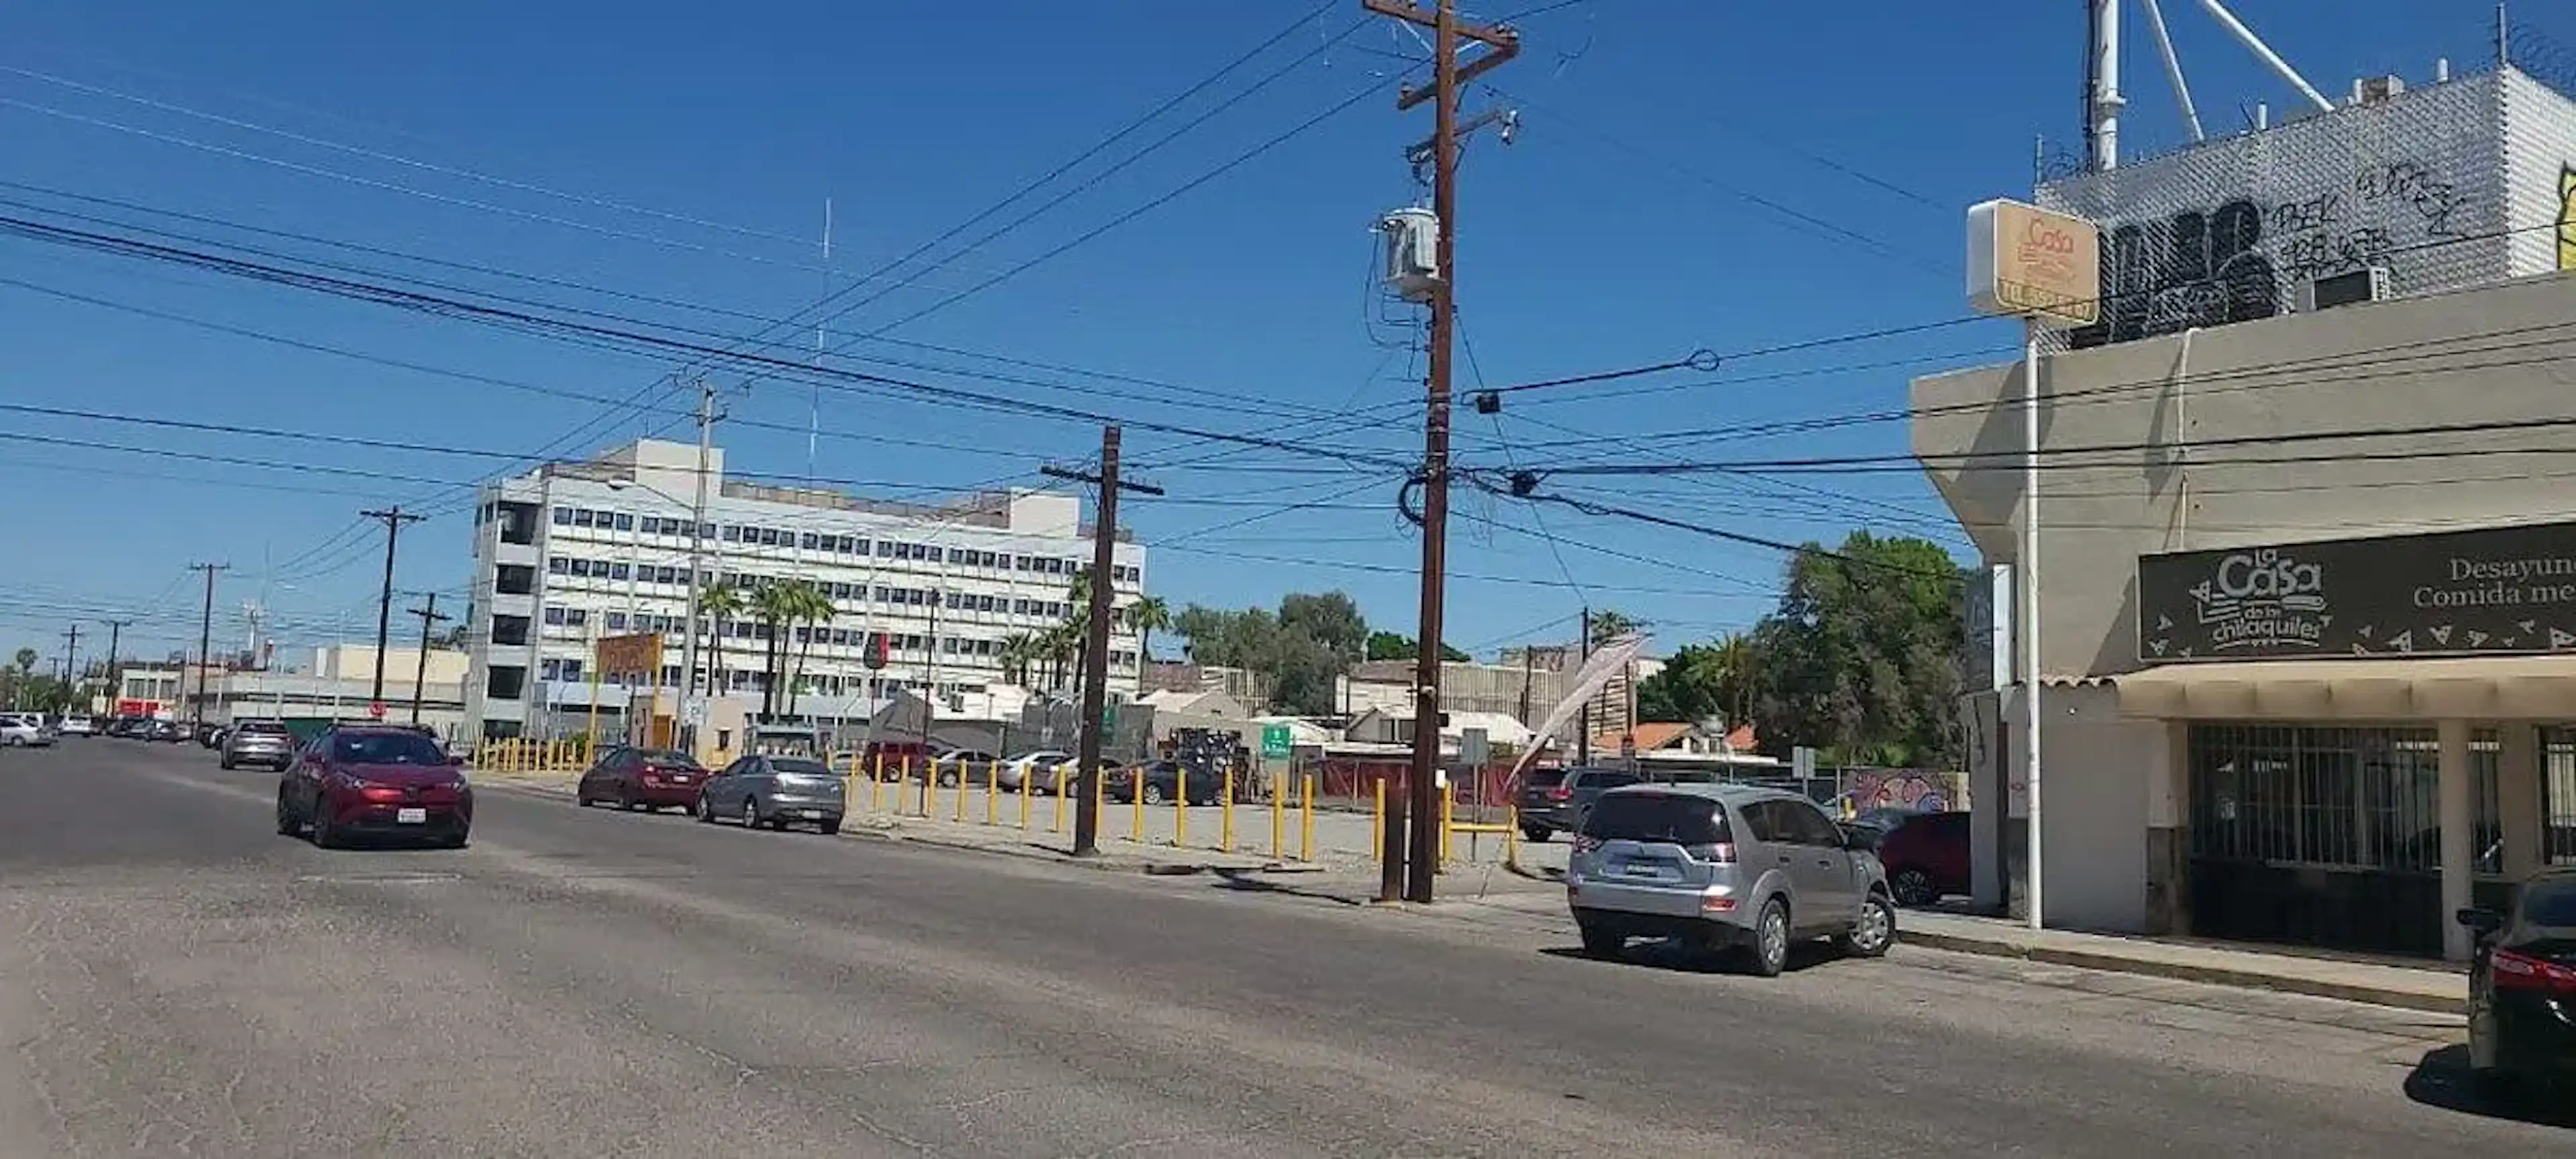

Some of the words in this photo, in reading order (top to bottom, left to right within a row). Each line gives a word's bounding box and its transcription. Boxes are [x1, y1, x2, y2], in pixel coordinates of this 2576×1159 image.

[2218, 553, 2322, 598] Casa
[2451, 557, 2576, 584] Desayun
[2414, 581, 2522, 607] Comida
[2245, 606, 2263, 618] de
[2213, 614, 2320, 642] chilaquiles
